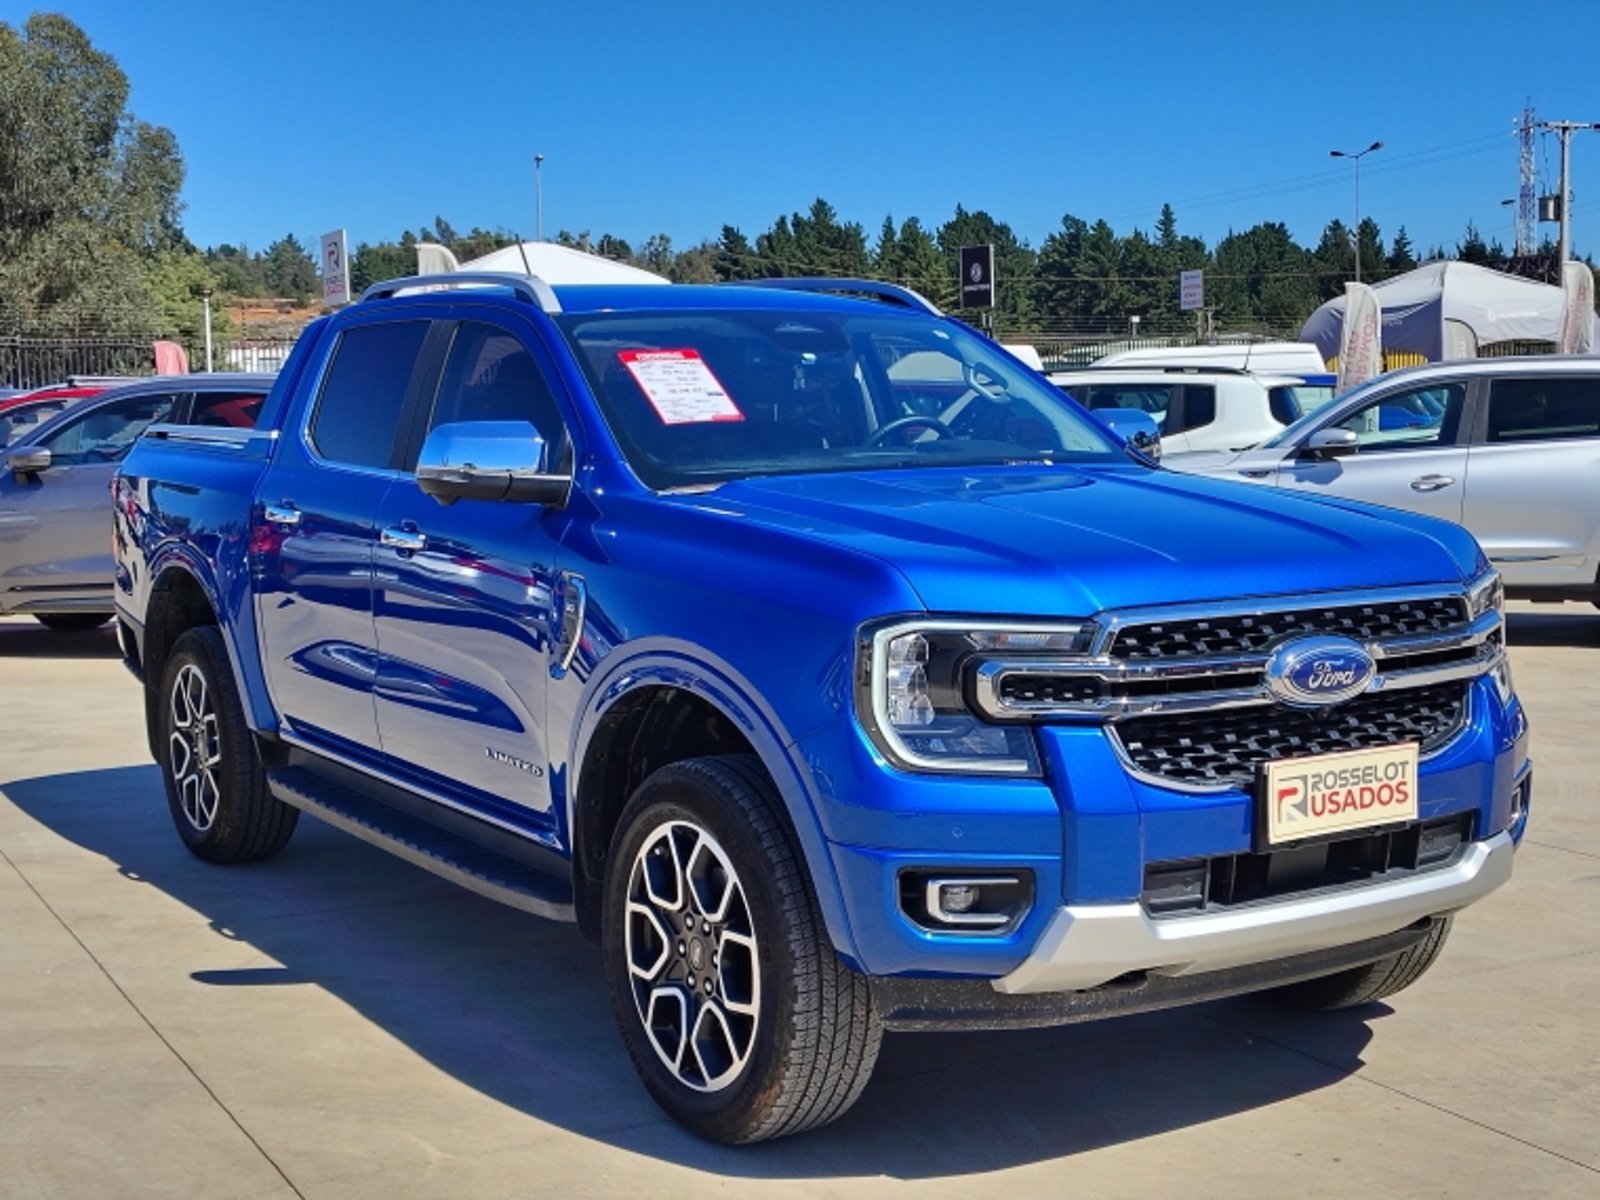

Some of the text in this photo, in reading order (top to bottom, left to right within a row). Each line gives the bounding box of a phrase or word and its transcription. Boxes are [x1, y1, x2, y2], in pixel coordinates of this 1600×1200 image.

[1308, 659, 1357, 689] Ford
[1311, 761, 1409, 792] ROSSELOT
[1311, 781, 1409, 817] USADOS
